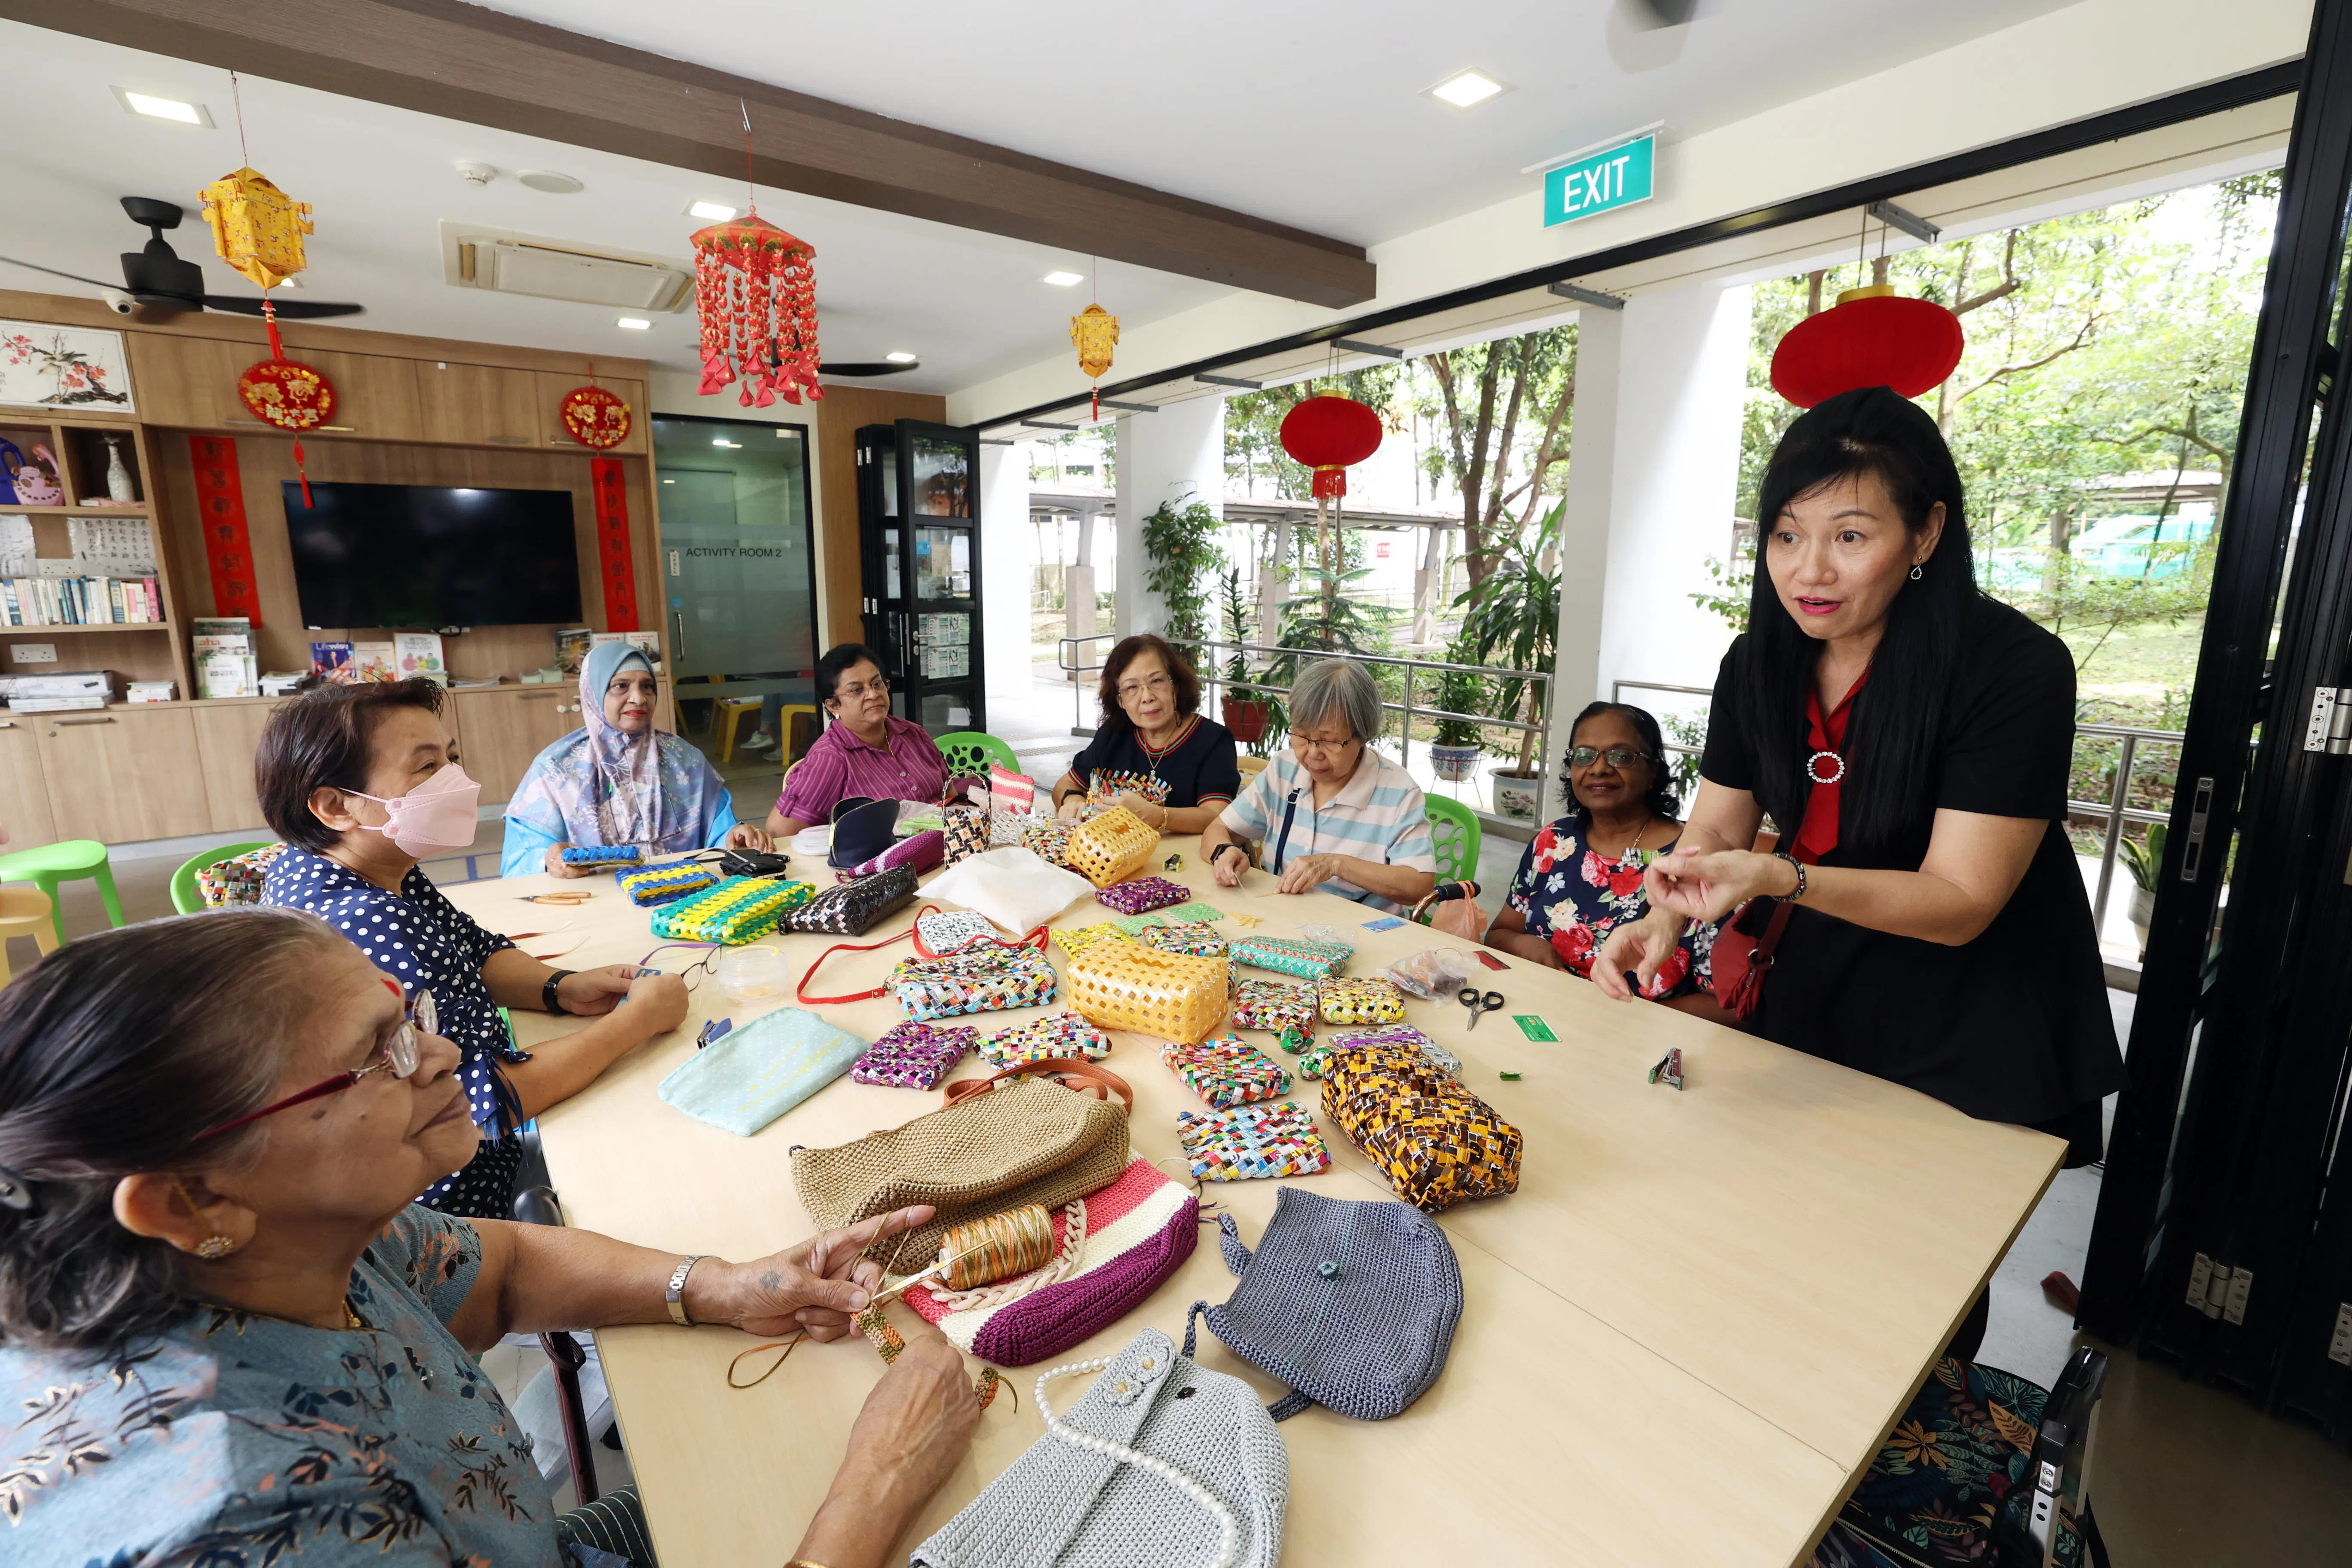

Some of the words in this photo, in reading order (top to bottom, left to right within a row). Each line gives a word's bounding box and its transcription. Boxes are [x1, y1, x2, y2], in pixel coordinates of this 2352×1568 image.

[1564, 155, 1630, 214] EXIT
[686, 548, 735, 557] ACTIVITY
[740, 548, 773, 557] ROOM
[776, 549, 782, 557] 2
